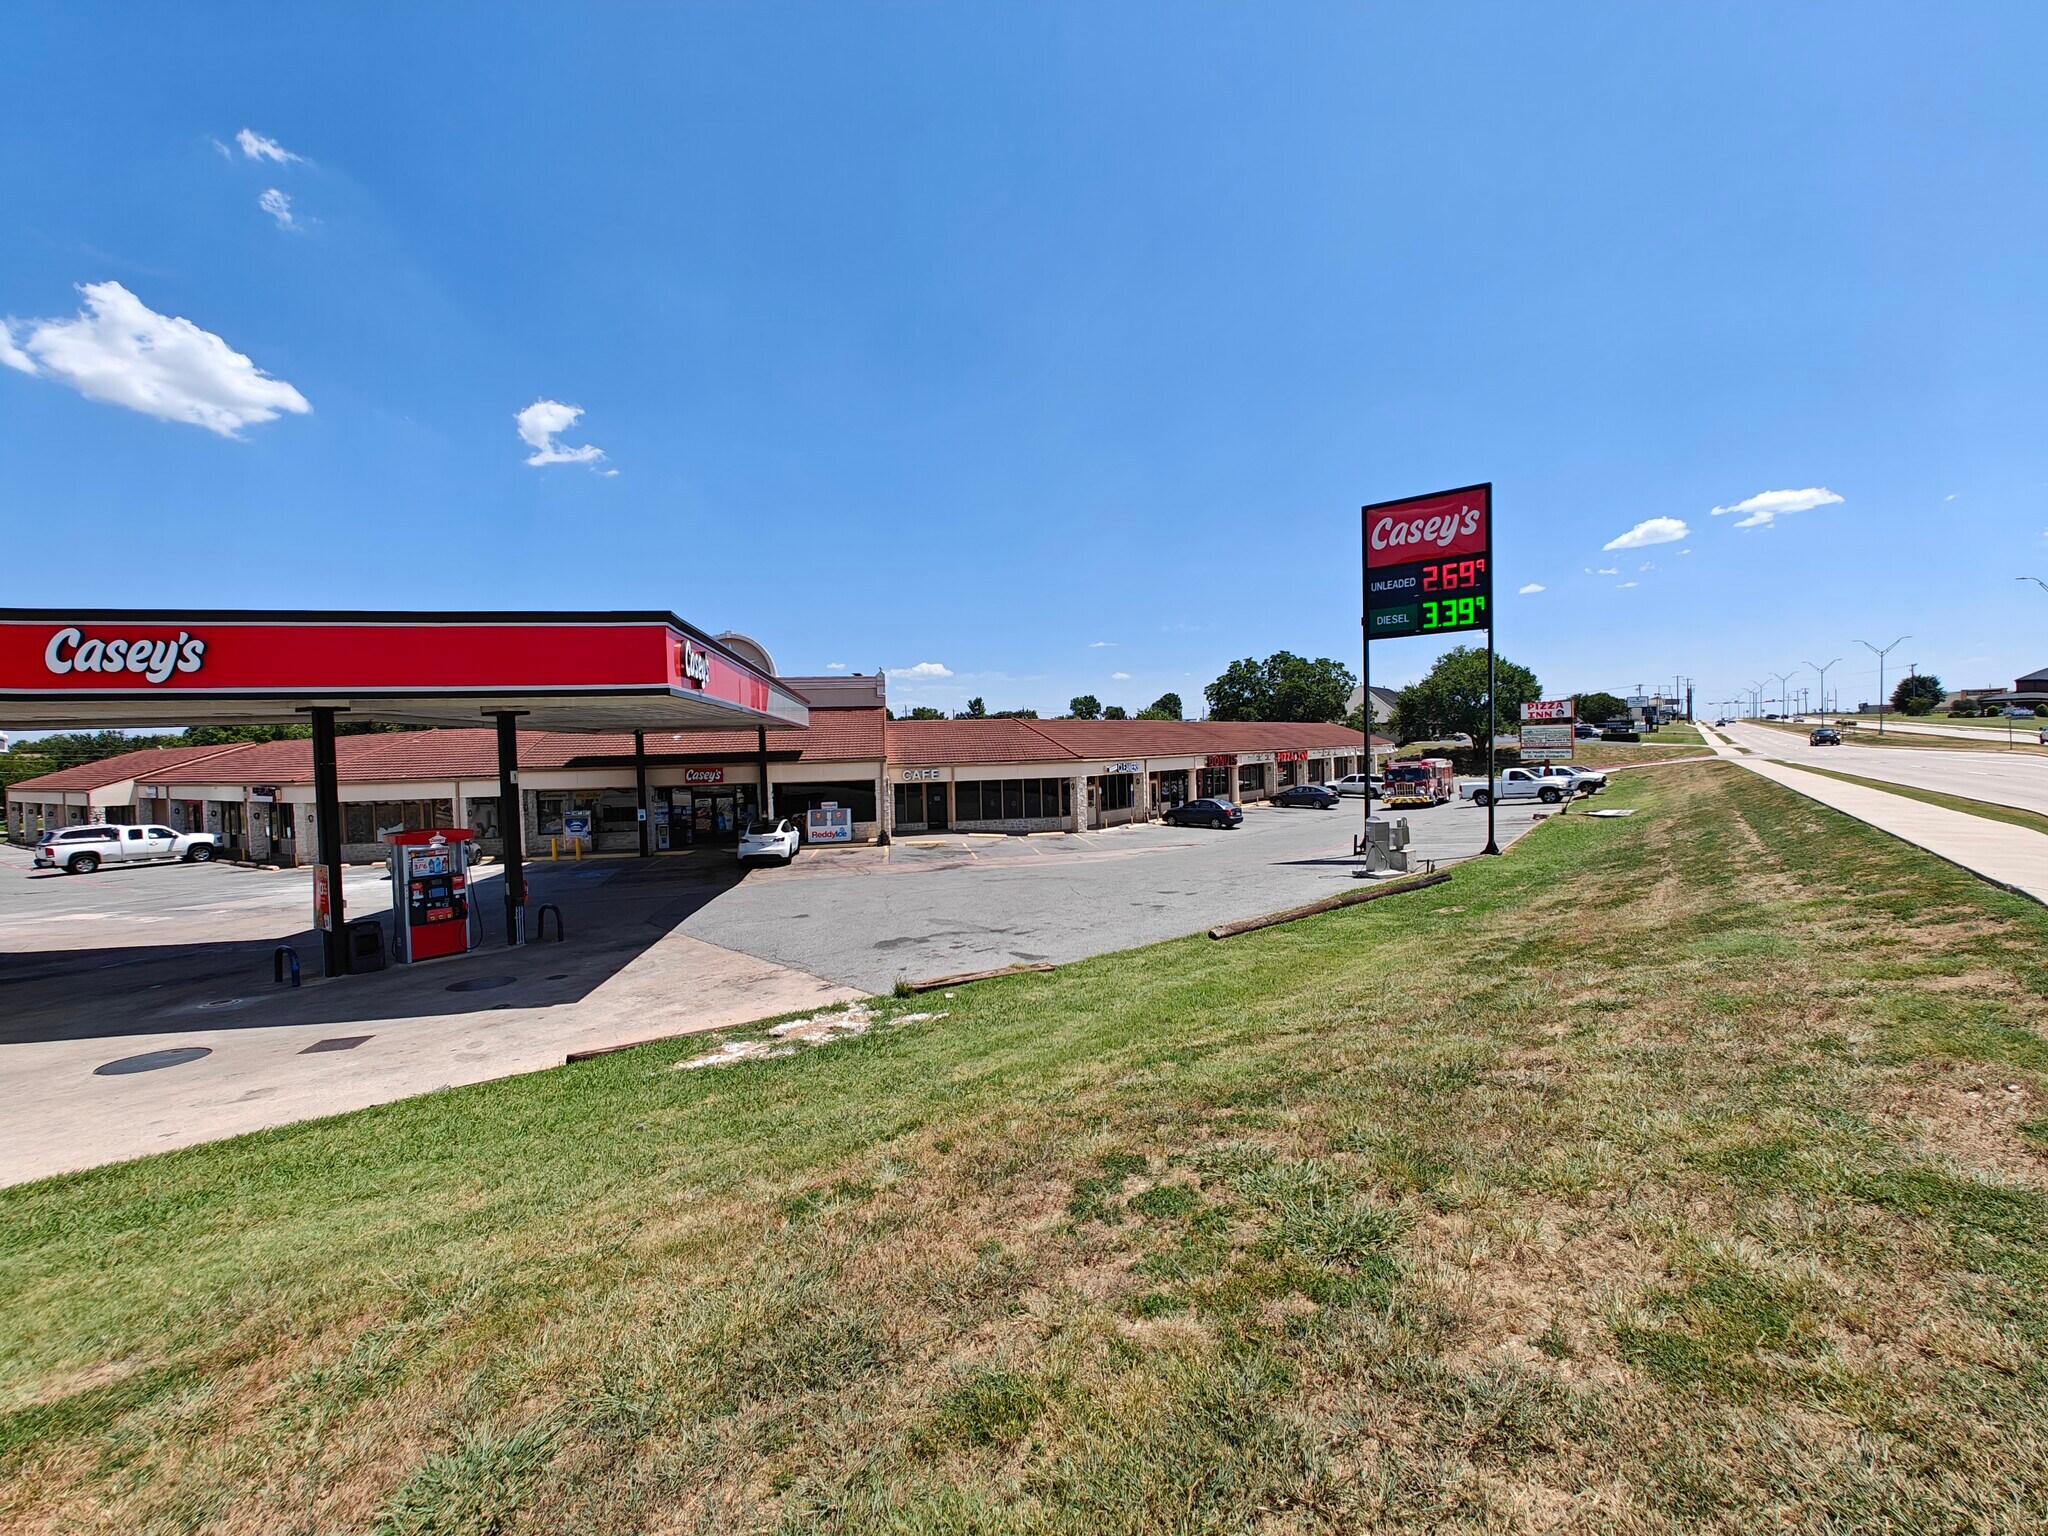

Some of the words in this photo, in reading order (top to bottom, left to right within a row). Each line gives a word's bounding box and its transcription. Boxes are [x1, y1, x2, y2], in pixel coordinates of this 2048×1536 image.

[1371, 506, 1480, 550] Casey's
[1371, 577, 1416, 592] UNLEADED
[1376, 613, 1410, 626] DIESEL
[44, 626, 206, 684] Casey's
[685, 640, 710, 689] Casey's
[1527, 702, 1564, 711] PIZZA
[1208, 754, 1238, 767] DONUTS
[1277, 752, 1294, 762] PIZZA
[685, 769, 722, 782] Casey's
[902, 768, 940, 781] CAFE
